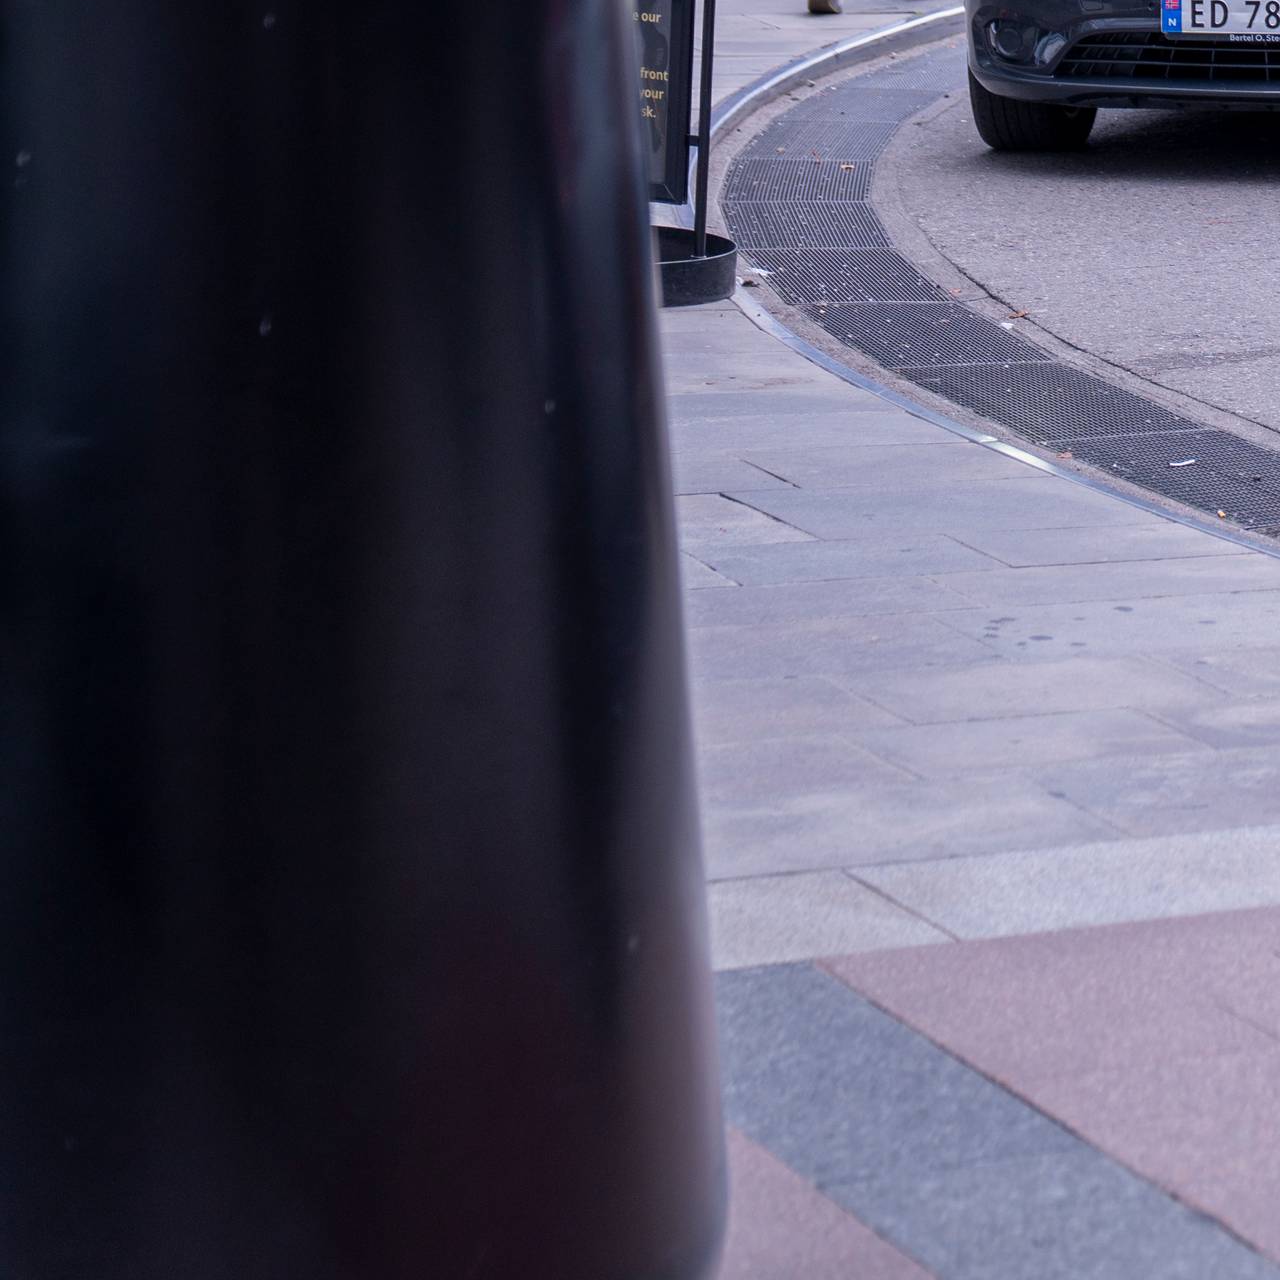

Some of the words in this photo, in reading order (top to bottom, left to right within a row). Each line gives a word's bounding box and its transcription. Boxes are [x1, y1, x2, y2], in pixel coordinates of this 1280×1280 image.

[641, 12, 661, 23] our
[1168, 18, 1177, 27] N
[1190, 0, 1229, 29] ED
[1229, 33, 1254, 42] Bertel
